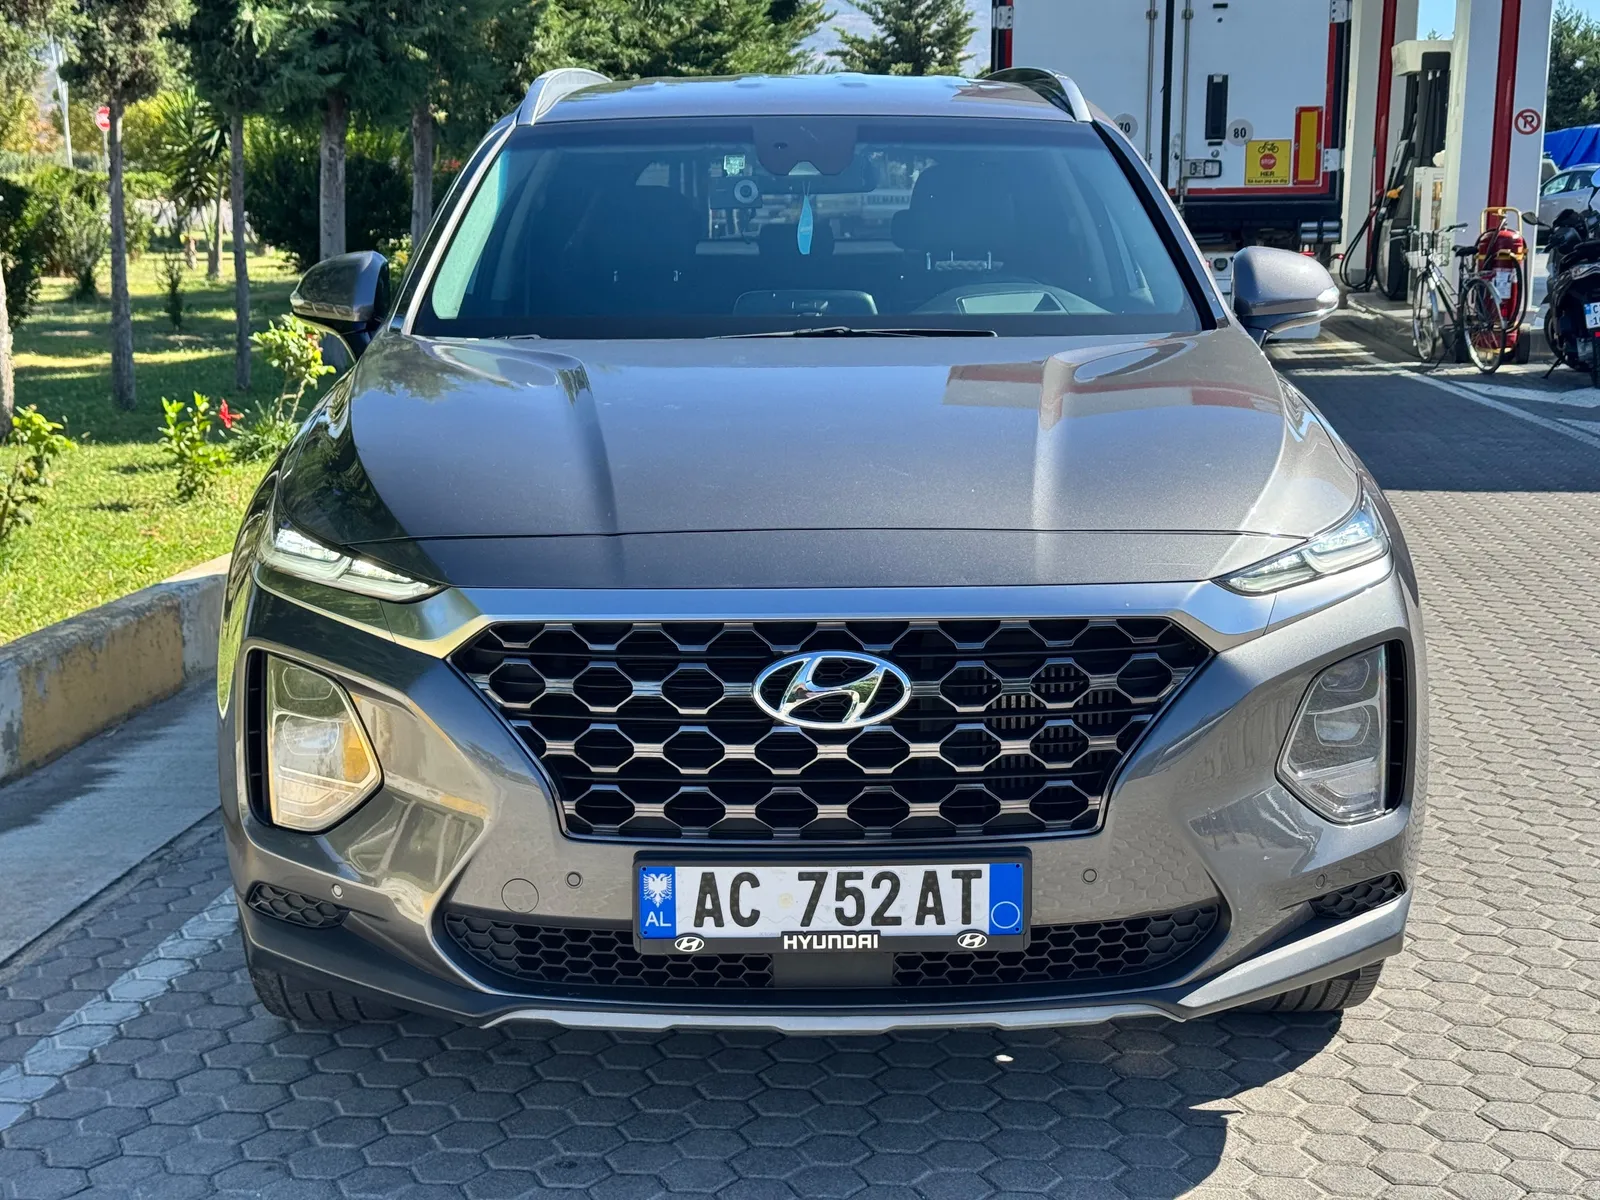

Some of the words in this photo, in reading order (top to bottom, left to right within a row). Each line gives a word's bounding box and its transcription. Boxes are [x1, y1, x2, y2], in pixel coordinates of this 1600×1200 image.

[1118, 122, 1131, 133] 70
[1233, 127, 1247, 139] 80
[1592, 304, 1600, 314] C
[693, 872, 761, 928] AC
[797, 871, 902, 928] 752
[915, 869, 983, 926] AT
[645, 911, 672, 927] AL
[783, 934, 879, 950] HYUNDAI
